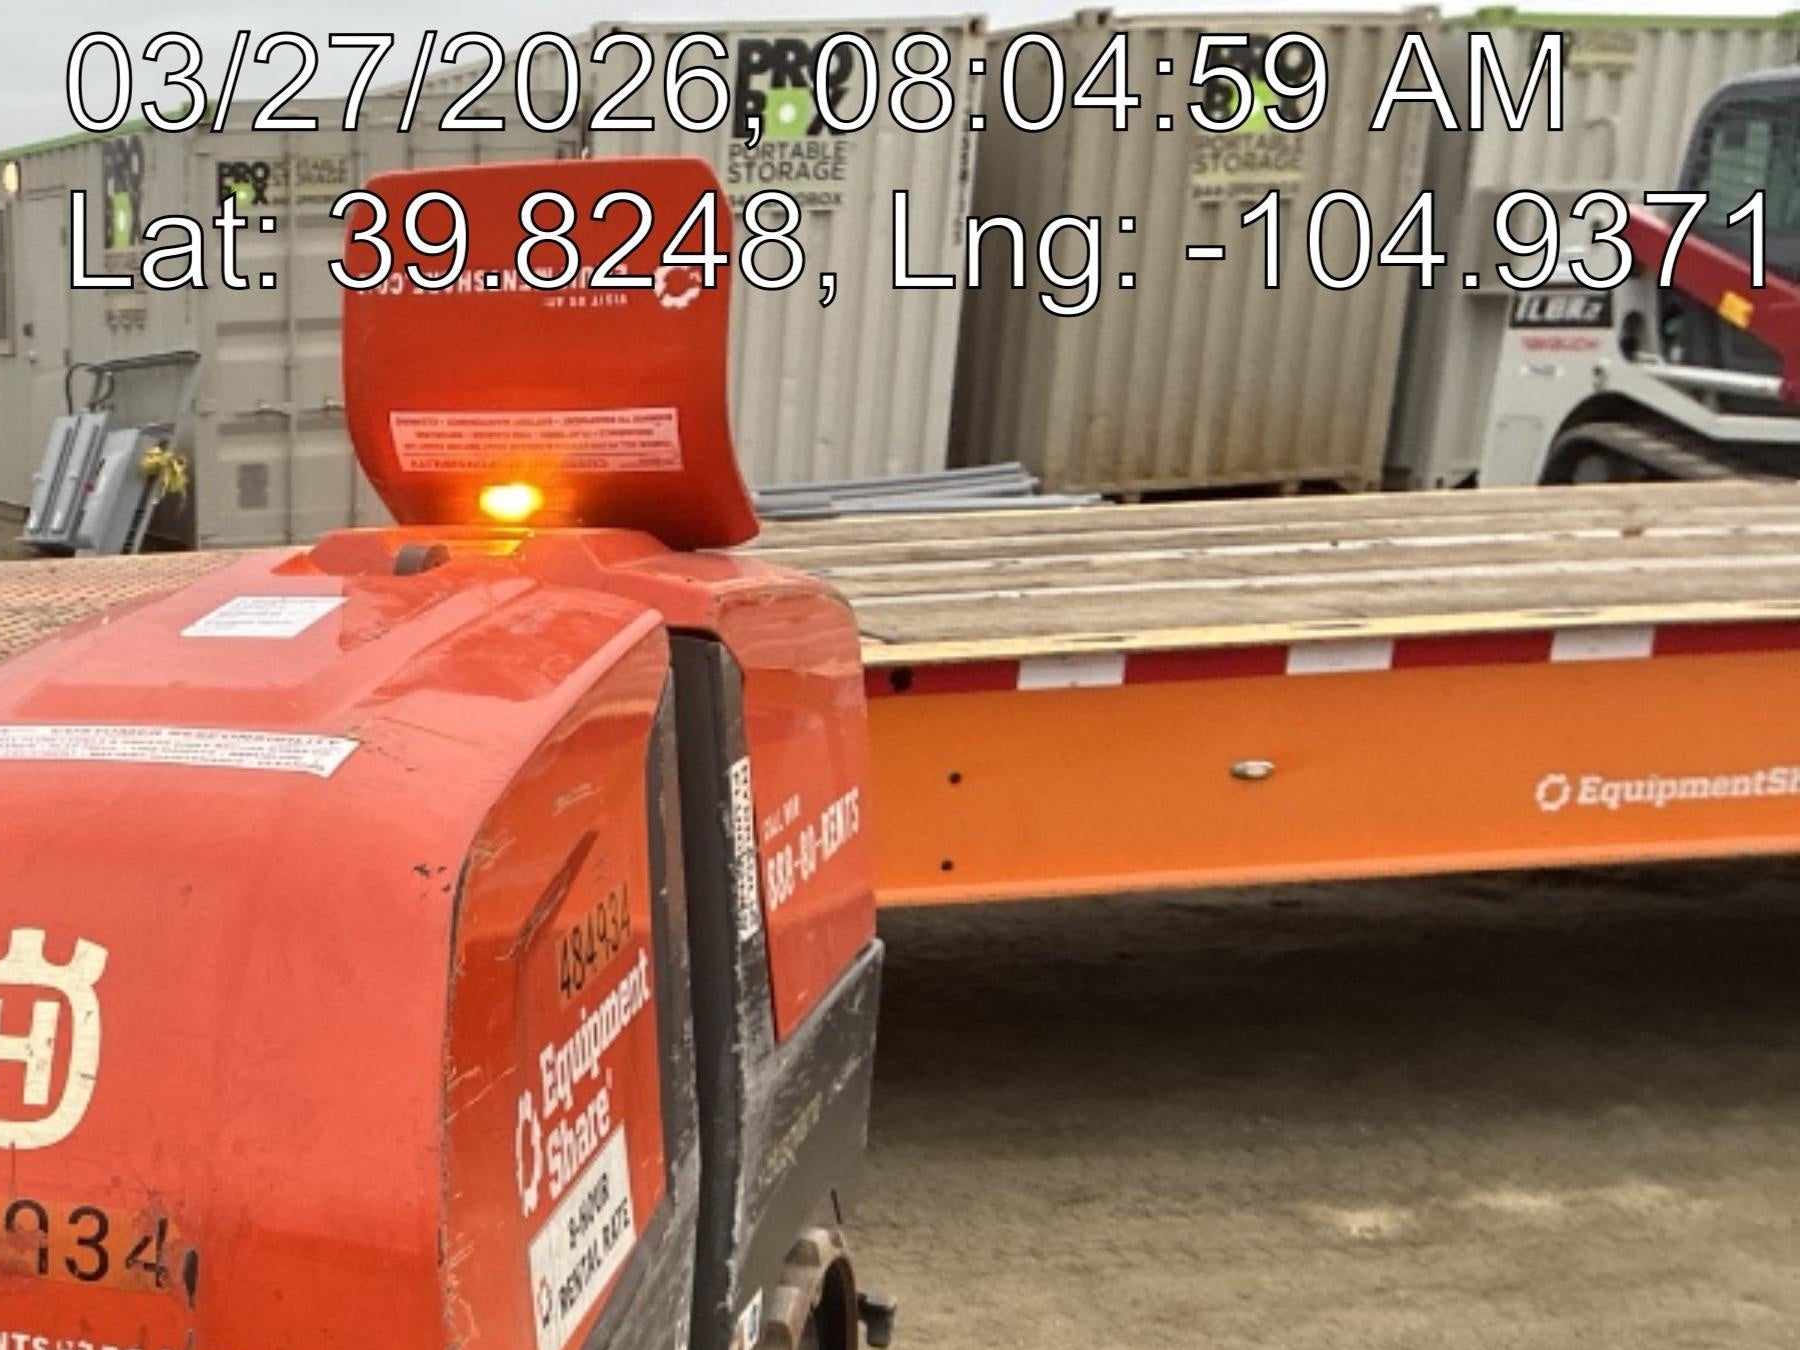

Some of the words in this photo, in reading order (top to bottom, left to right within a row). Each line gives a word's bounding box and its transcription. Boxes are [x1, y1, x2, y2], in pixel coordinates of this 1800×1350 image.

[727, 140, 847, 162] PORTABLE
[727, 160, 847, 184] STORAGE
[561, 880, 631, 1000] 484934
[540, 947, 650, 1120] Equipment
[547, 1086, 610, 1200] Share
[559, 1237, 602, 1320] RENTAL
[602, 1196, 630, 1253] RATE
